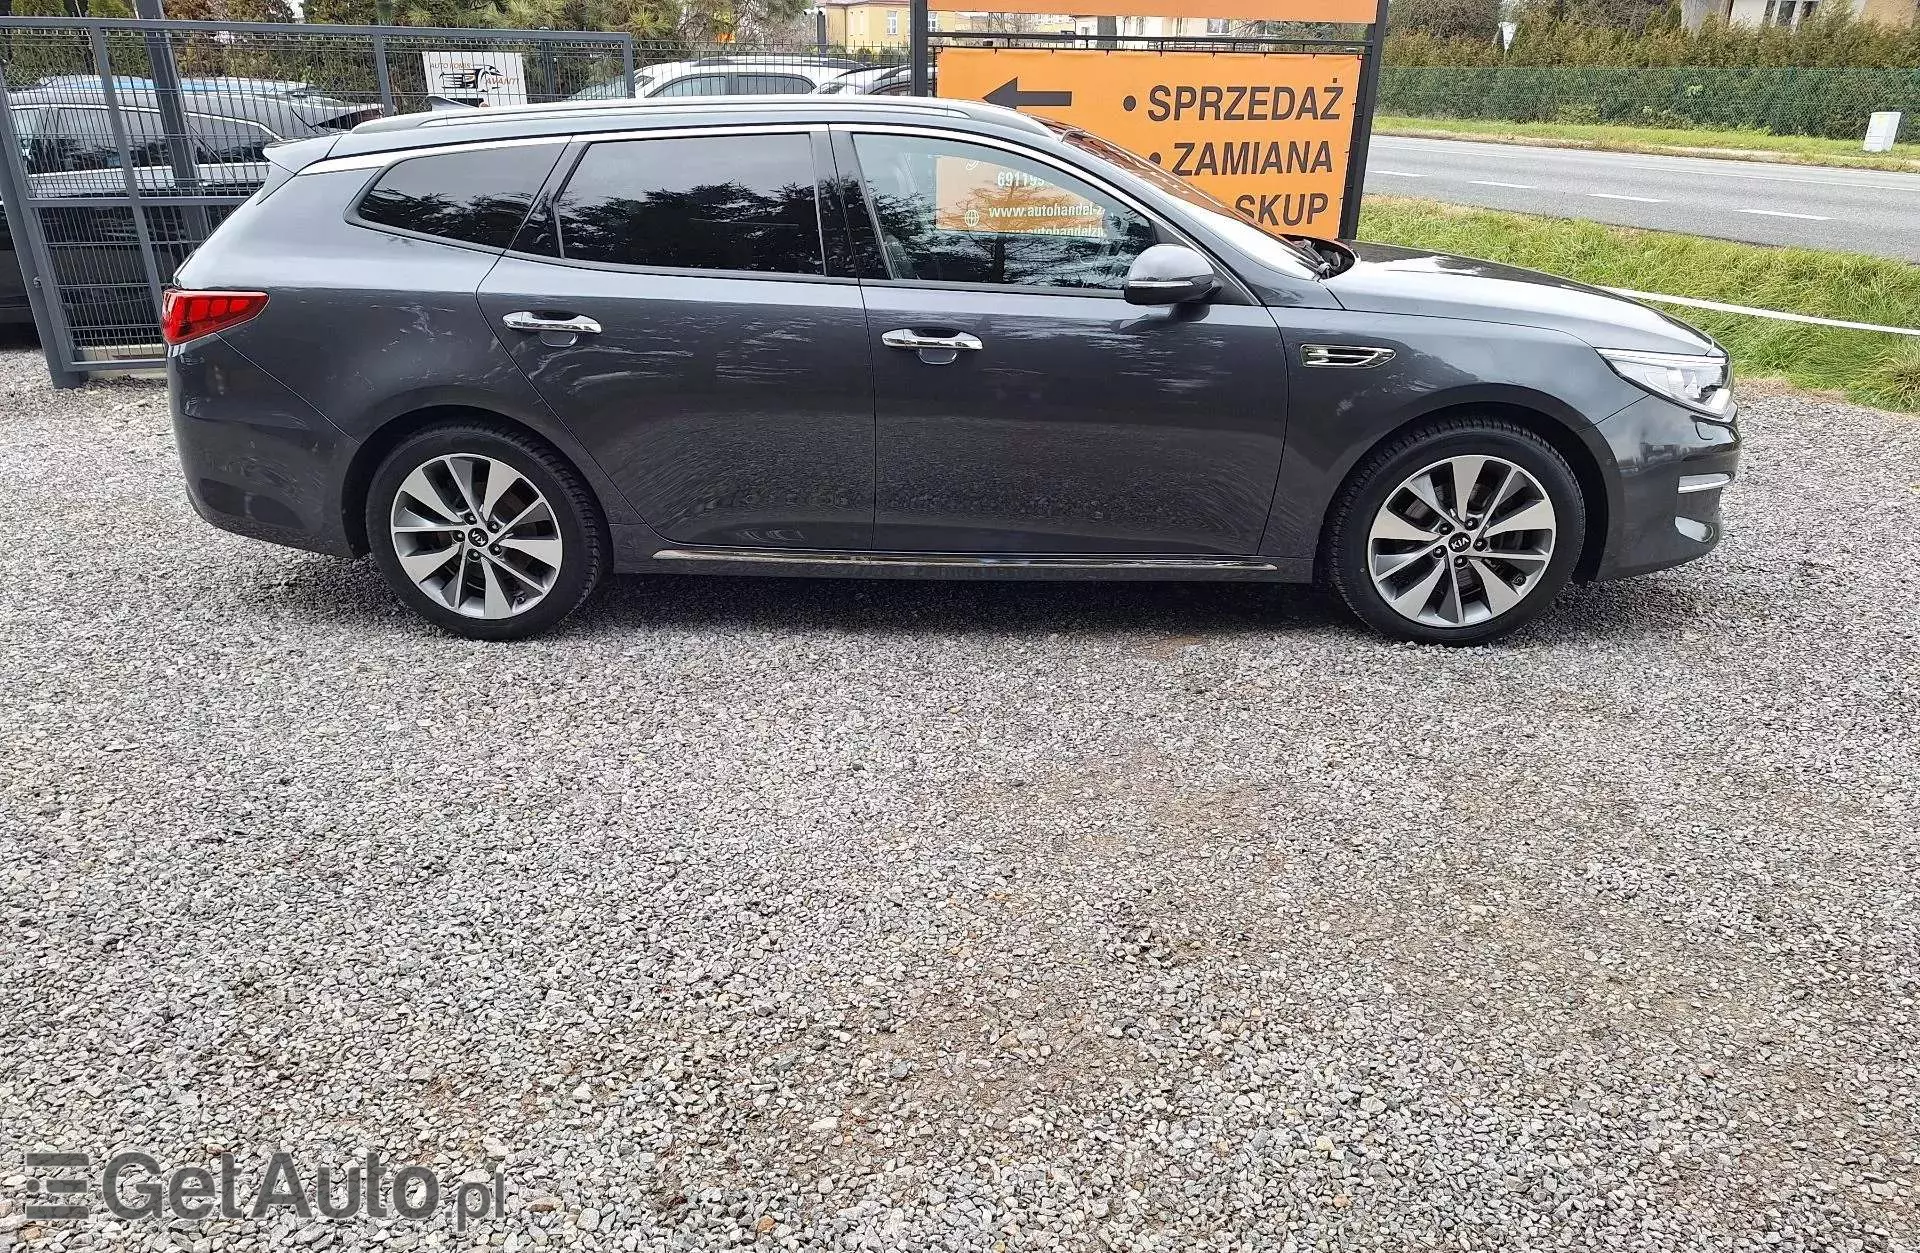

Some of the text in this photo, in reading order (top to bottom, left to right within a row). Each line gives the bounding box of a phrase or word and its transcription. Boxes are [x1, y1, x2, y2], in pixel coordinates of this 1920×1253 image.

[1148, 78, 1344, 122] SPRZEDAŻ
[1172, 141, 1333, 176] ZAMIANA
[1235, 193, 1329, 227] SKUP
[471, 530, 486, 545] KIA
[1451, 537, 1469, 549] KIA
